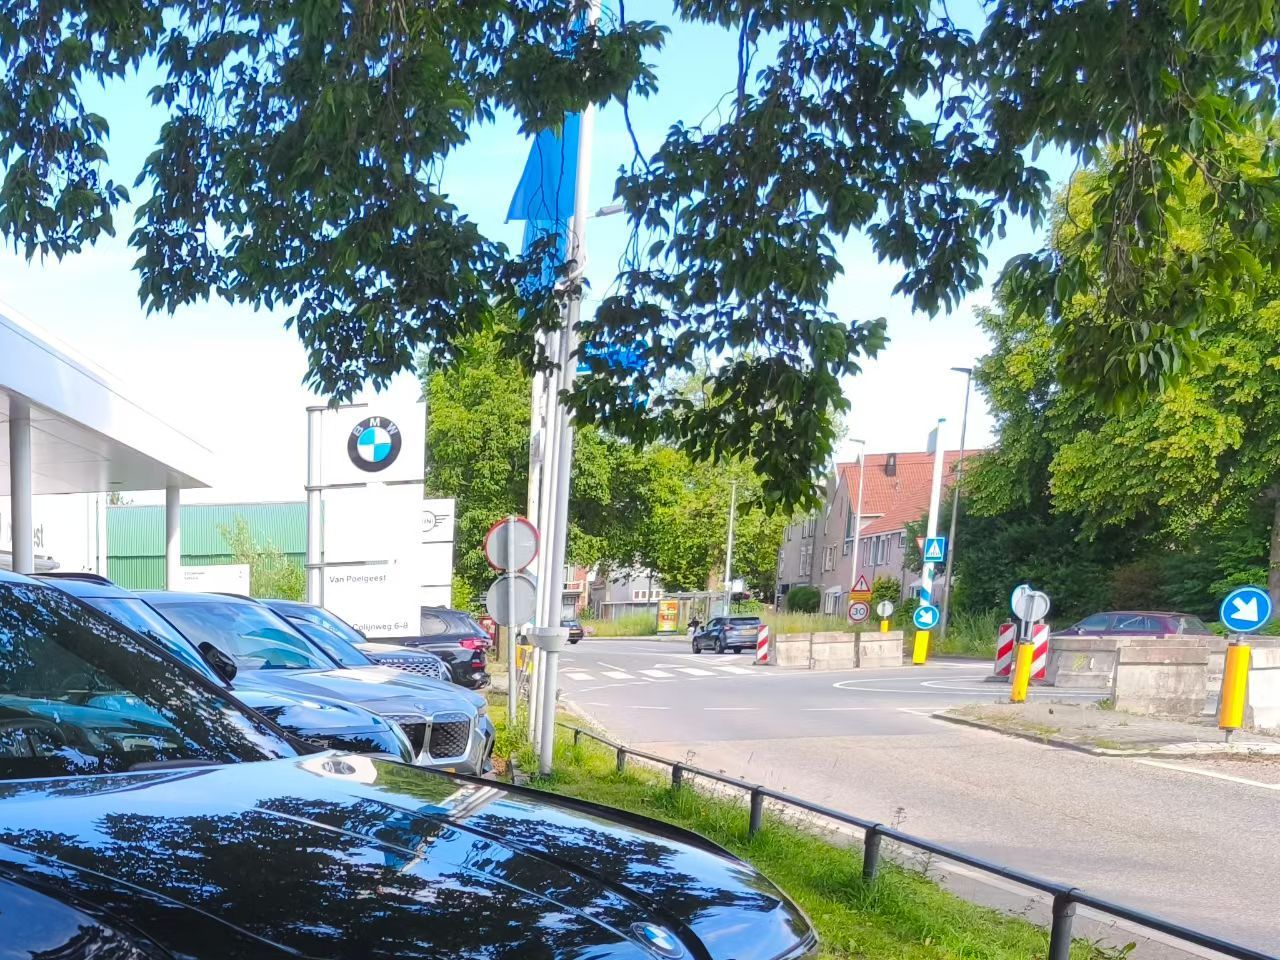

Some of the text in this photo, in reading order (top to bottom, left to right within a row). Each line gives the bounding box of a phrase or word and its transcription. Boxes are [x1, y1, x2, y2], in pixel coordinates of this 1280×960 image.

[352, 417, 398, 437] BMW
[346, 574, 386, 583] Poelgeest
[852, 607, 866, 616] 30
